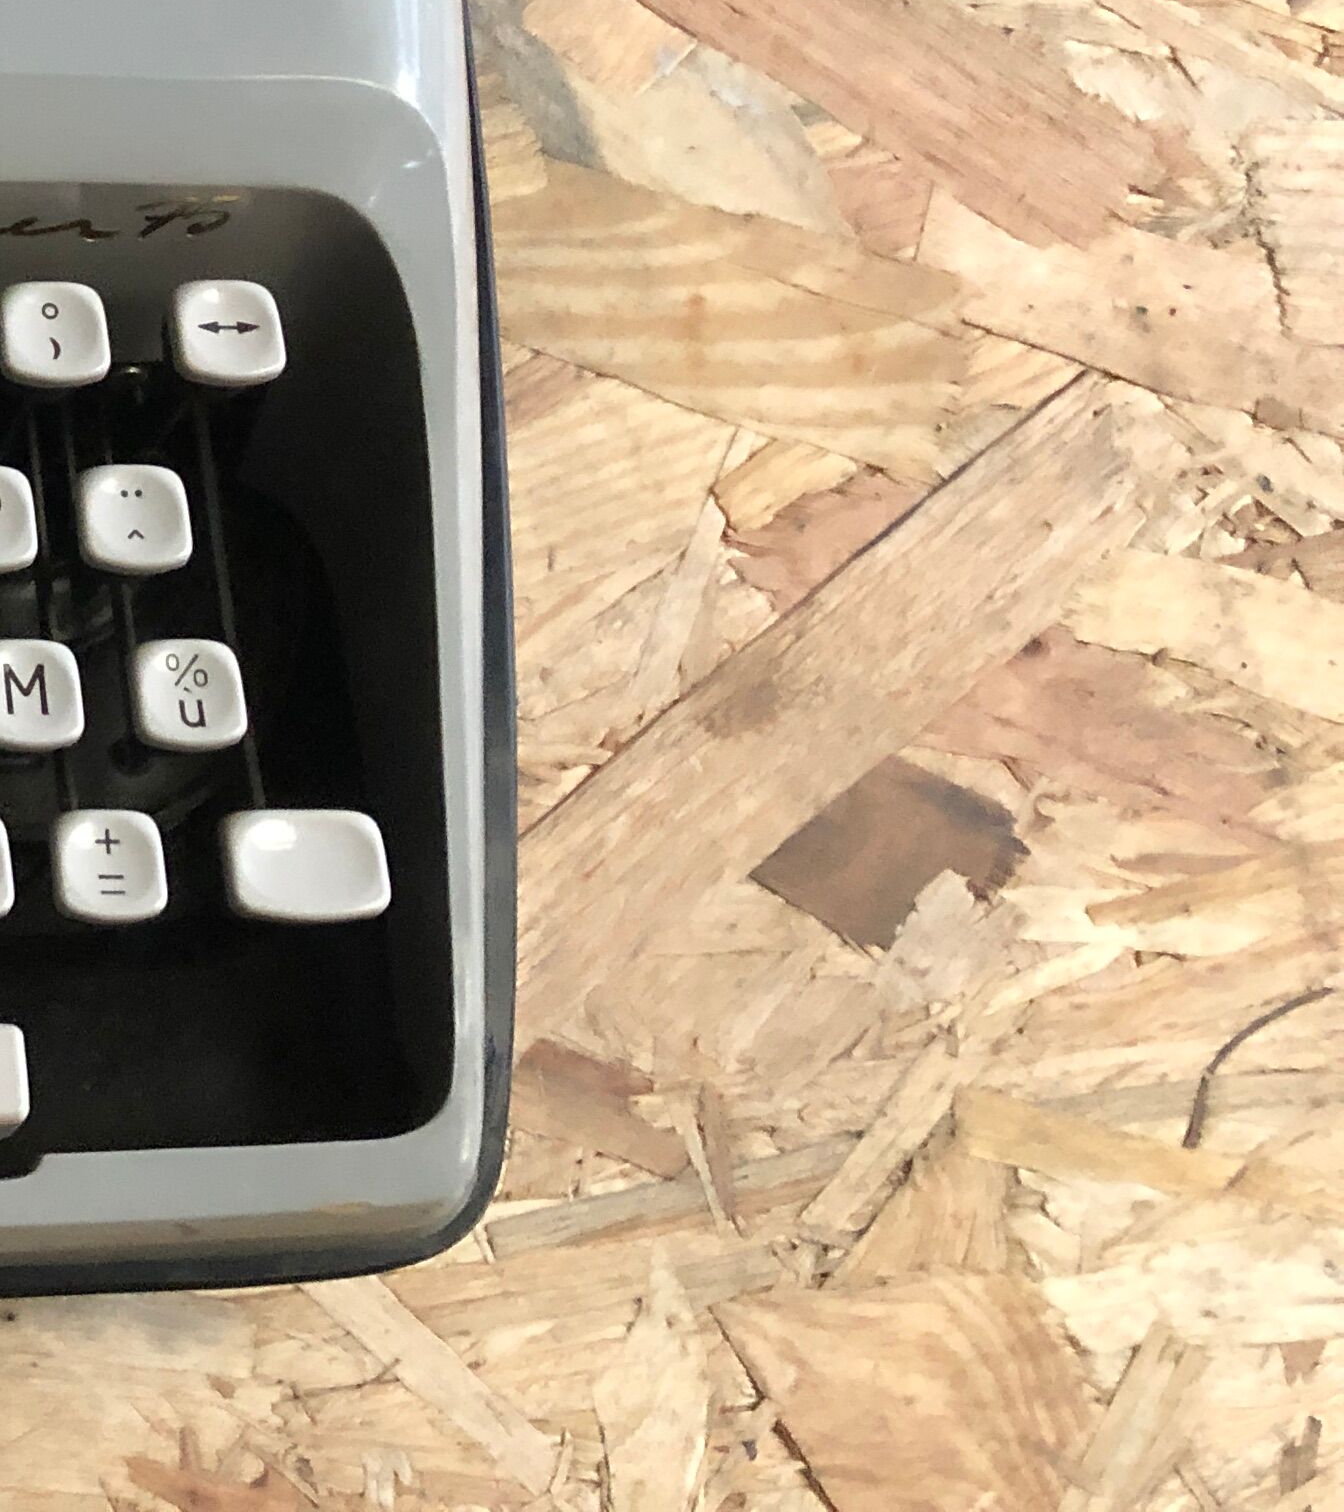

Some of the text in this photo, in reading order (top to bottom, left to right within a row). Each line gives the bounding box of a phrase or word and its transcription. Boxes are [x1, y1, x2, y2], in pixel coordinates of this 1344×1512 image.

[3, 663, 50, 716] M
[165, 653, 209, 693] %
[178, 687, 207, 729] ù
